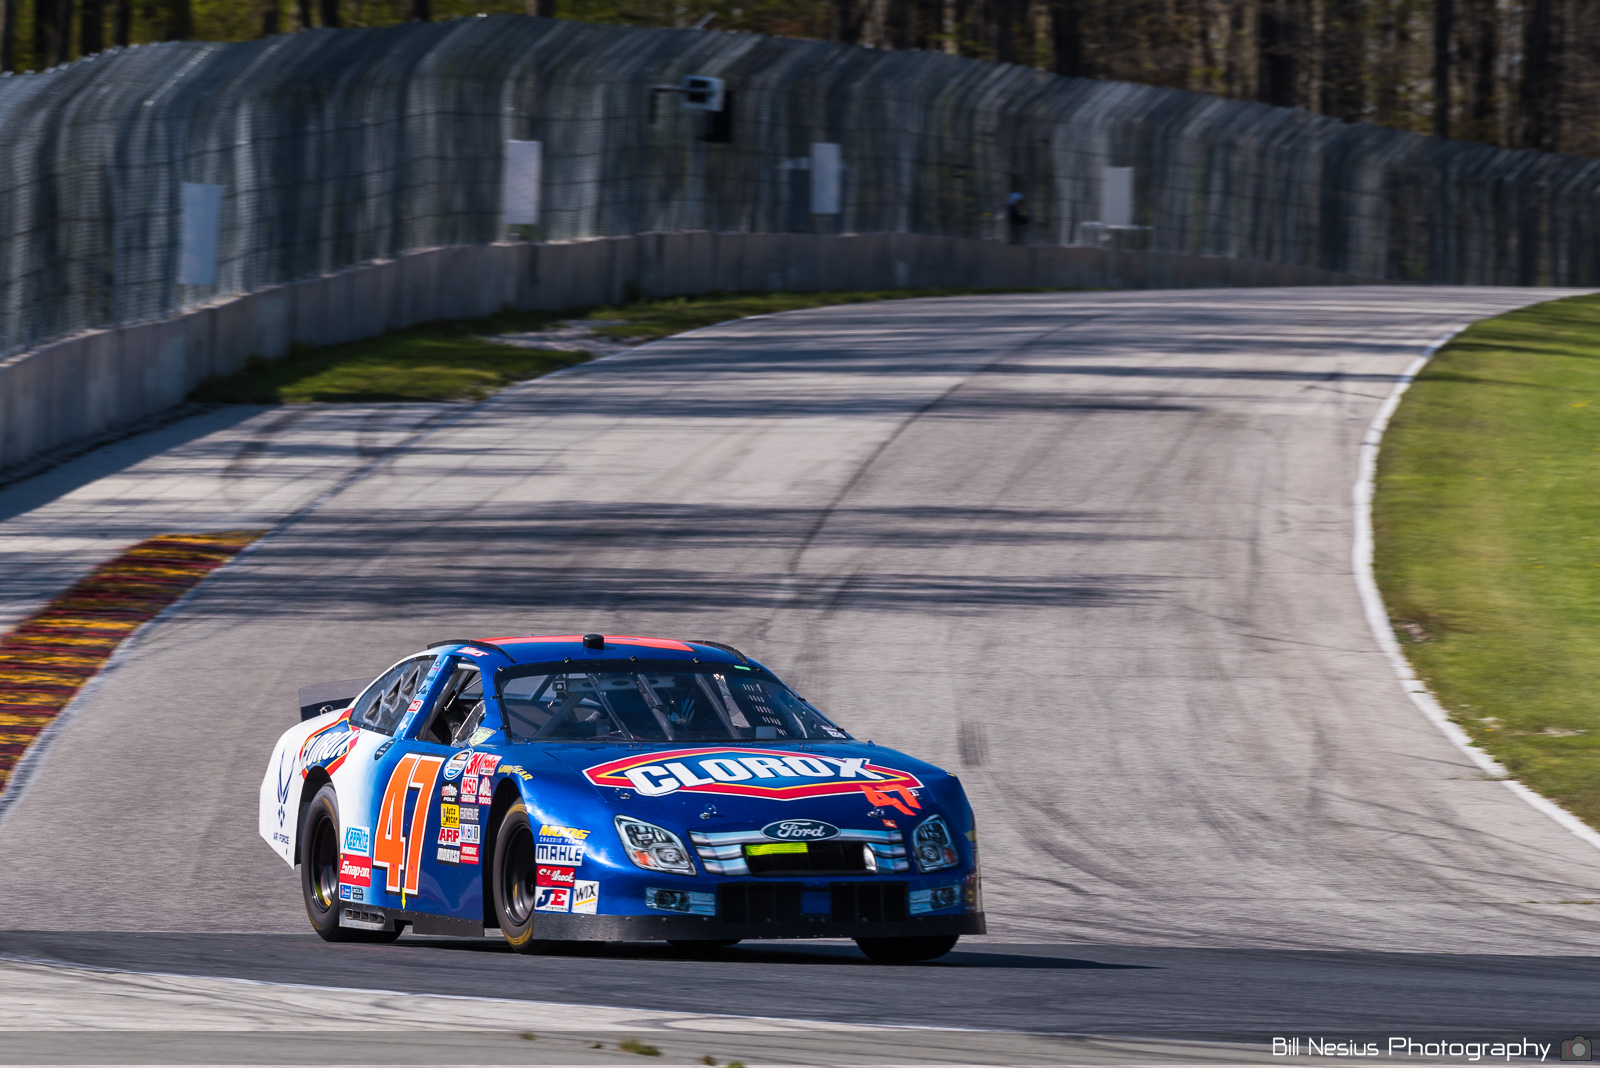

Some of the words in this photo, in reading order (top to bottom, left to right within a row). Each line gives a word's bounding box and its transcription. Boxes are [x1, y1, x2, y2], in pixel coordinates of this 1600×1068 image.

[466, 753, 485, 776] 3M
[624, 755, 885, 796] CLOROX
[462, 779, 476, 794] MSD
[859, 784, 922, 815] 47
[374, 753, 448, 897] 47
[539, 825, 591, 839] MOOG
[777, 821, 826, 838] Ford
[439, 828, 460, 842] ARP
[537, 845, 582, 861] MAHLE
[340, 860, 370, 880] Snap-on
[536, 889, 567, 908] JE
[575, 884, 596, 901] WIX
